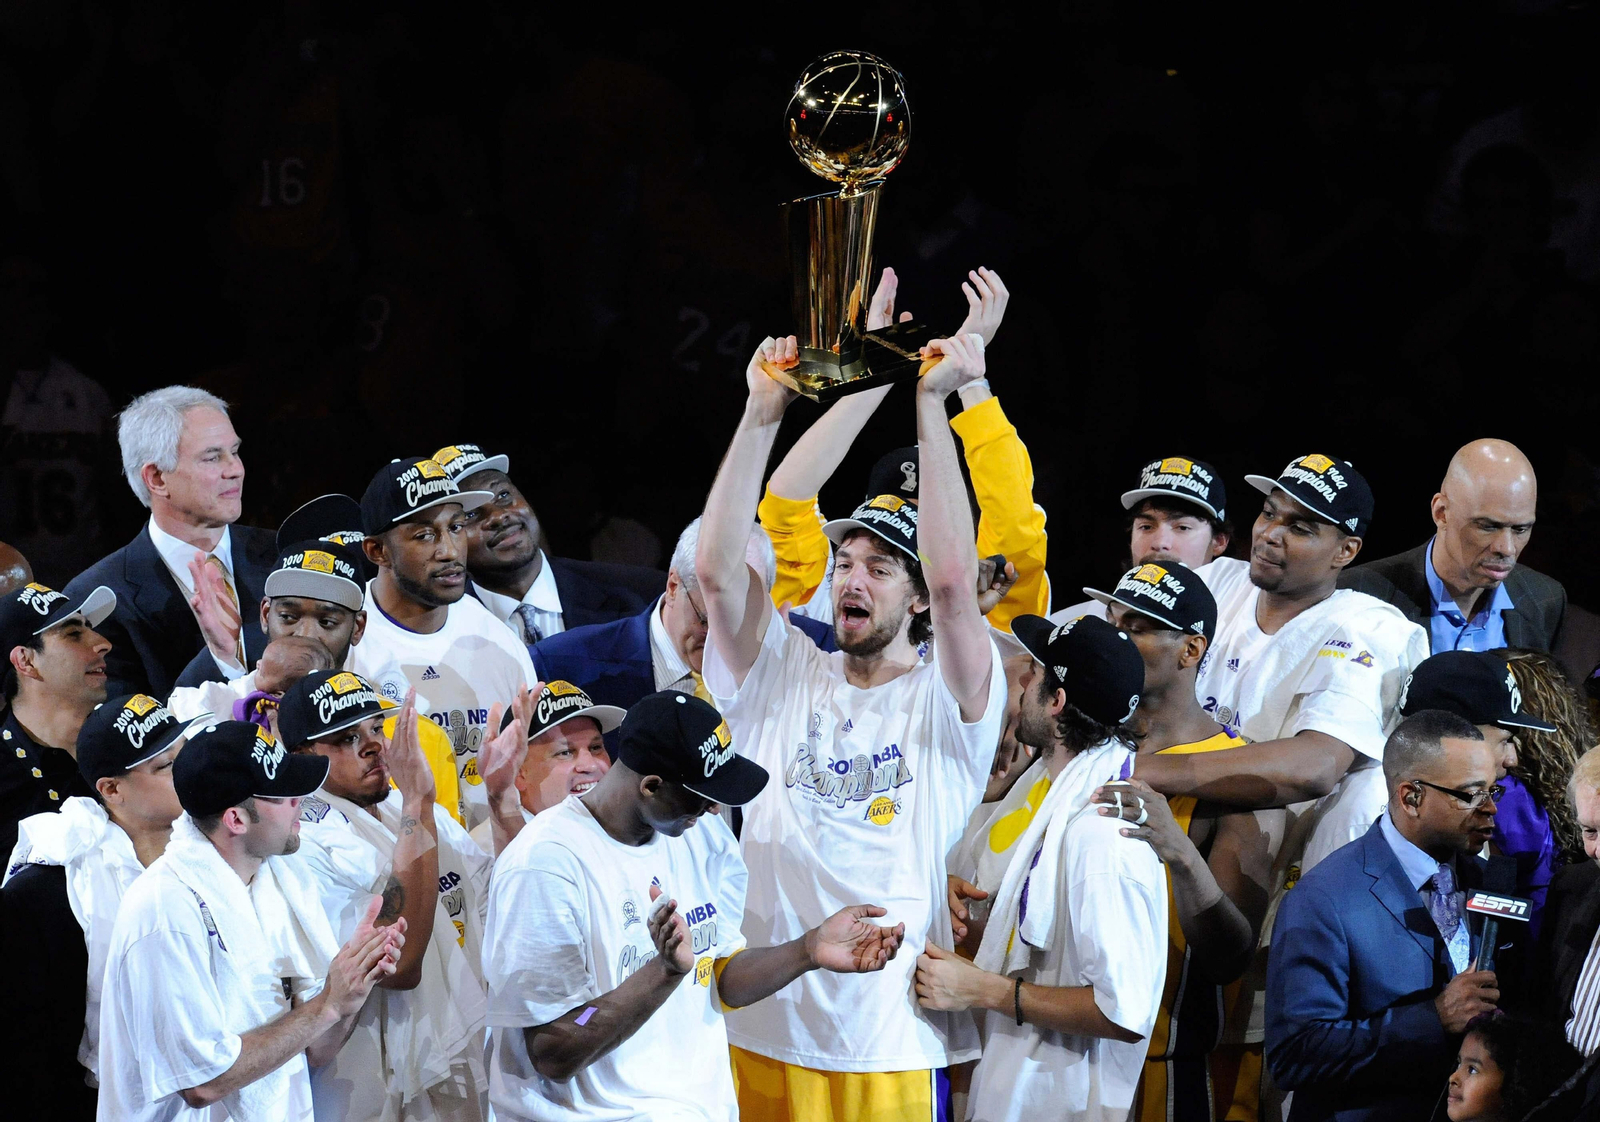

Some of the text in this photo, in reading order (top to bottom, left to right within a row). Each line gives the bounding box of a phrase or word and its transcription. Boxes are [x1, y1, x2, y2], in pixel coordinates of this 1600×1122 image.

[259, 156, 307, 207] 16
[672, 306, 751, 380] 24
[396, 467, 419, 488] 2010
[1140, 471, 1209, 500] Champions
[283, 553, 304, 569] 2010
[17, 587, 36, 605] 2010
[421, 673, 441, 681] adidas
[309, 682, 333, 705] 2010
[113, 708, 134, 733] 2010
[467, 708, 491, 725] NB
[251, 738, 267, 764] 2010
[698, 734, 718, 759] 2010
[873, 743, 903, 769] NBA
[785, 743, 913, 808] Champions
[862, 801, 902, 821] LAKERS
[685, 902, 717, 927] NBA
[1471, 893, 1528, 915] ESPN
